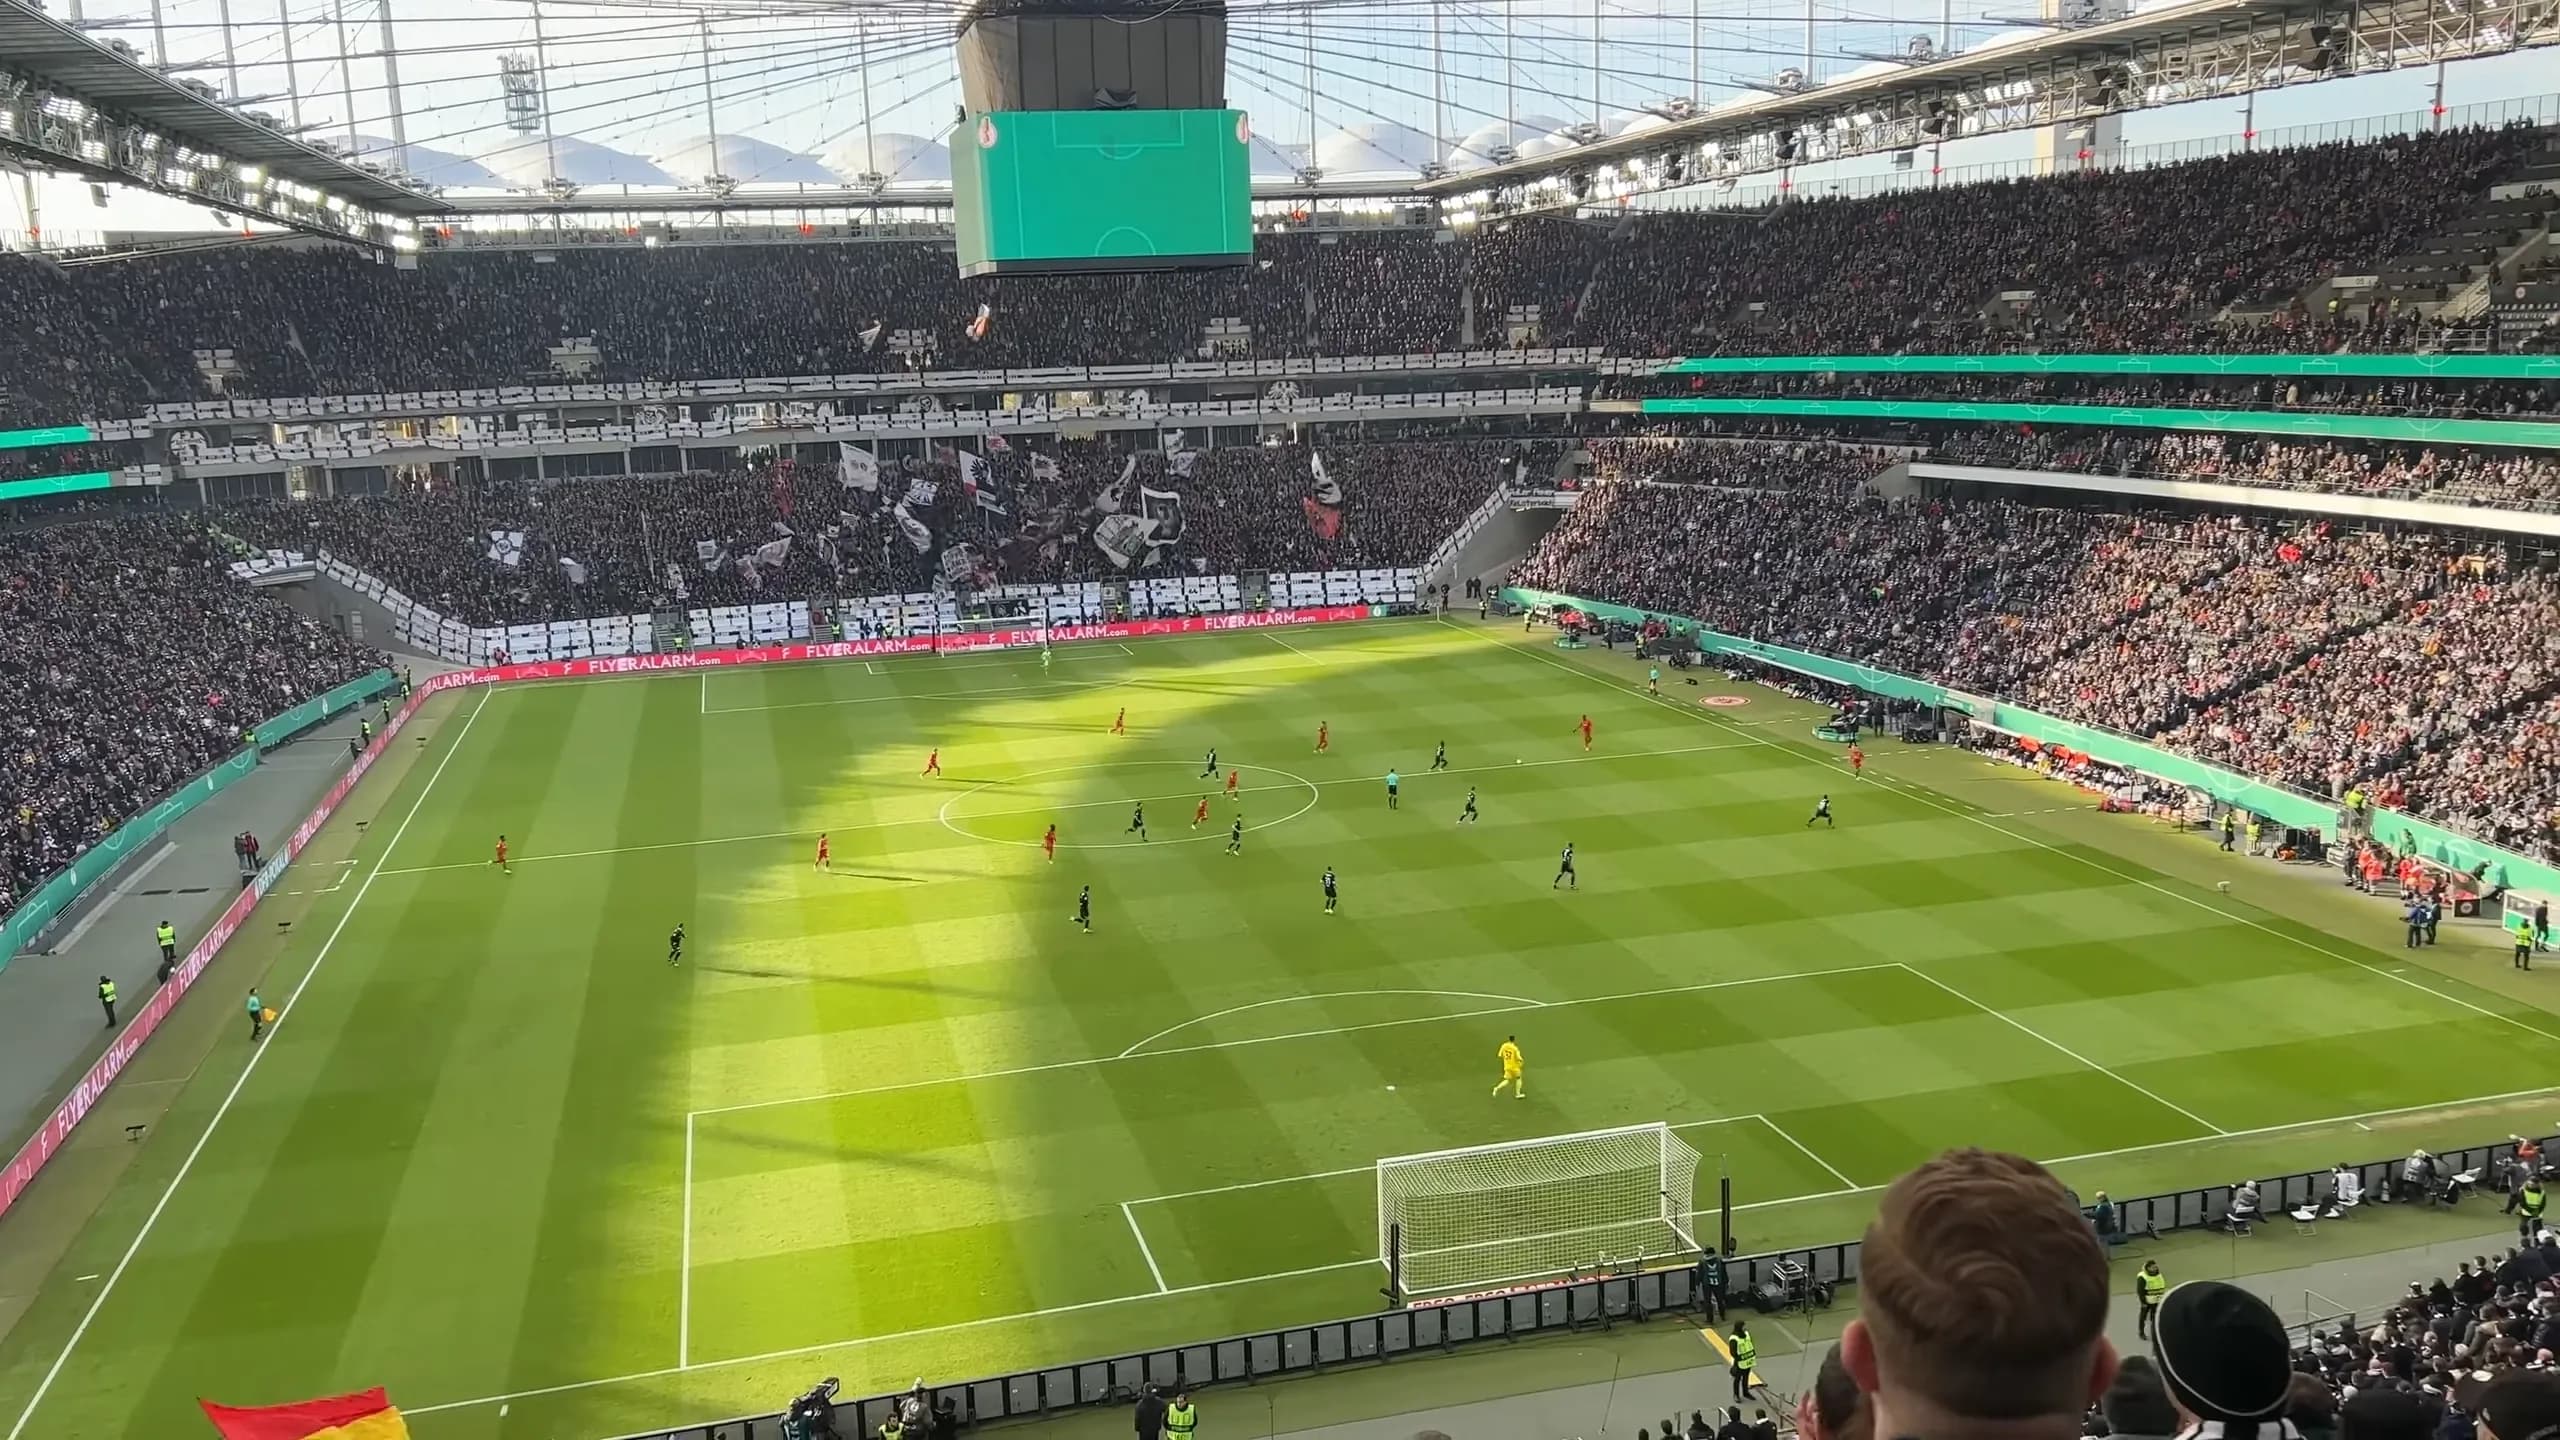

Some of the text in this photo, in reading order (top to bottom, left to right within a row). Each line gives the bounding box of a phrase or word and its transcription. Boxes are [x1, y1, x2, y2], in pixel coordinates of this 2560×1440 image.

[1204, 611, 1316, 630] FLYERALARM.com
[1010, 625, 1129, 643] FLYERALARM.com
[805, 638, 930, 658] FLYERALARM.com
[588, 653, 721, 674] FLYERALARM.com
[178, 923, 234, 994] FLYERALARM.com
[57, 1037, 139, 1140] FLYERALARM.com
